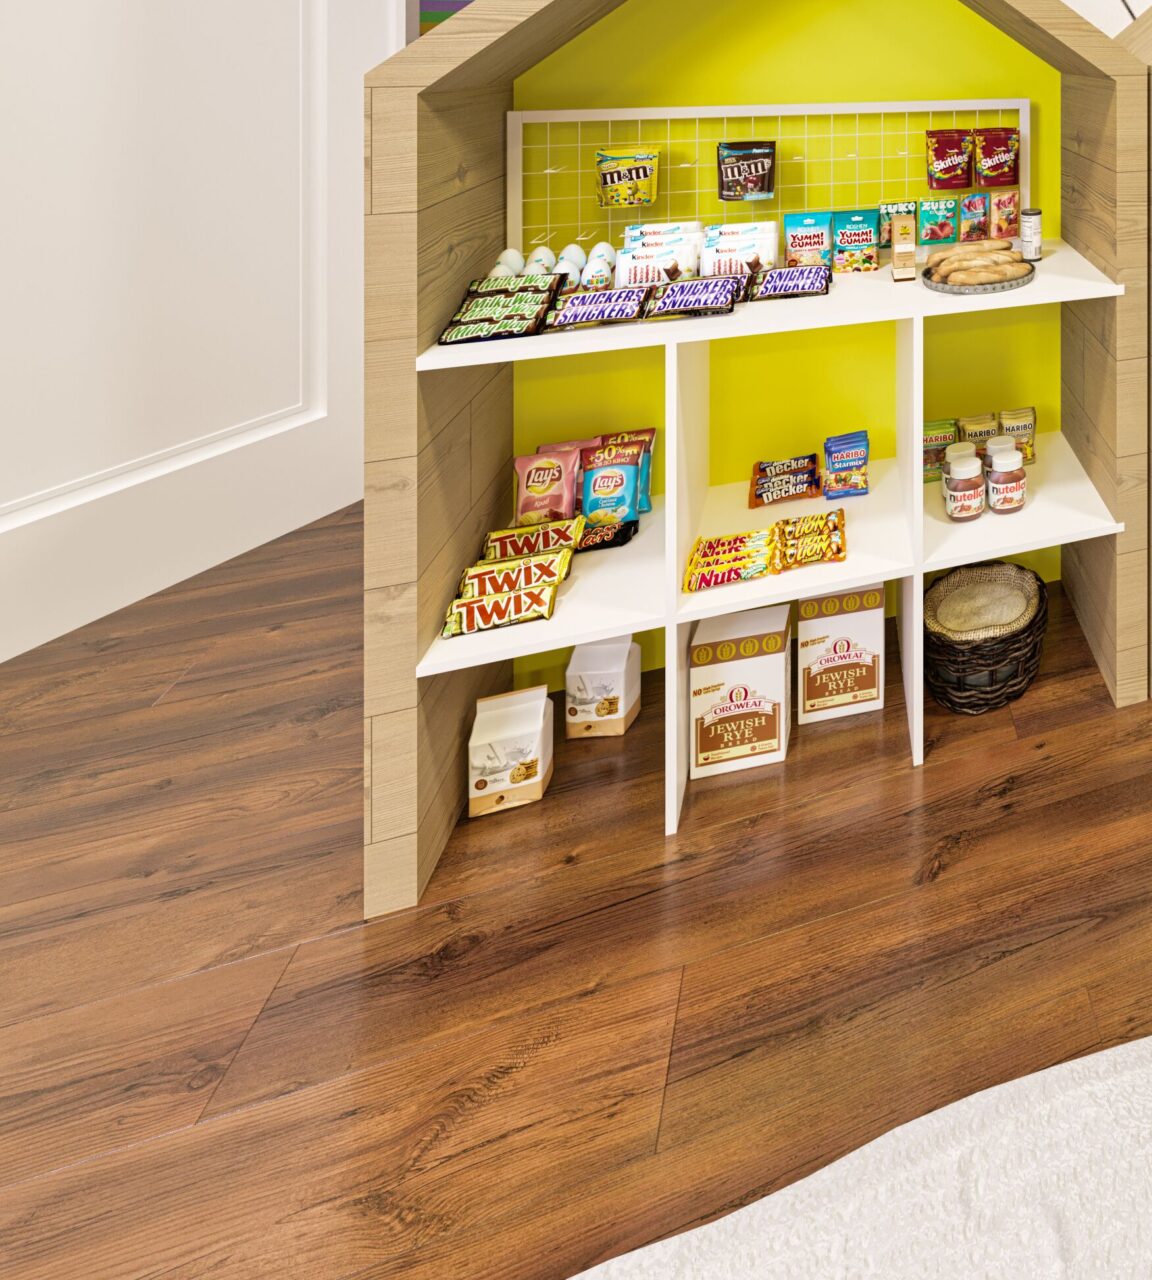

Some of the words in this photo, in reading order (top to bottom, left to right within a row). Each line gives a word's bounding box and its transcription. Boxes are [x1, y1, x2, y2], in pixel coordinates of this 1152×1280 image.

[933, 154, 969, 172] Skittles
[981, 151, 1015, 169] Skittles
[921, 200, 955, 211] ZUKO
[766, 266, 829, 284] SNICKERS
[667, 279, 738, 298] SNICKERS
[569, 288, 645, 308] SNICKERS
[557, 302, 639, 325] SNICKERS
[968, 429, 996, 439] HARIBO
[1005, 423, 1032, 432] HARIBO
[832, 449, 866, 461] HARIBO
[833, 459, 865, 469] Starmix
[698, 568, 741, 589] Nuts
[820, 652, 864, 666] OROWEAT
[815, 666, 867, 686] JEWISH
[828, 678, 855, 691] RYE
[713, 701, 763, 716] OROWEAT
[709, 716, 767, 738] JEWISH
[724, 728, 753, 742] RYE
